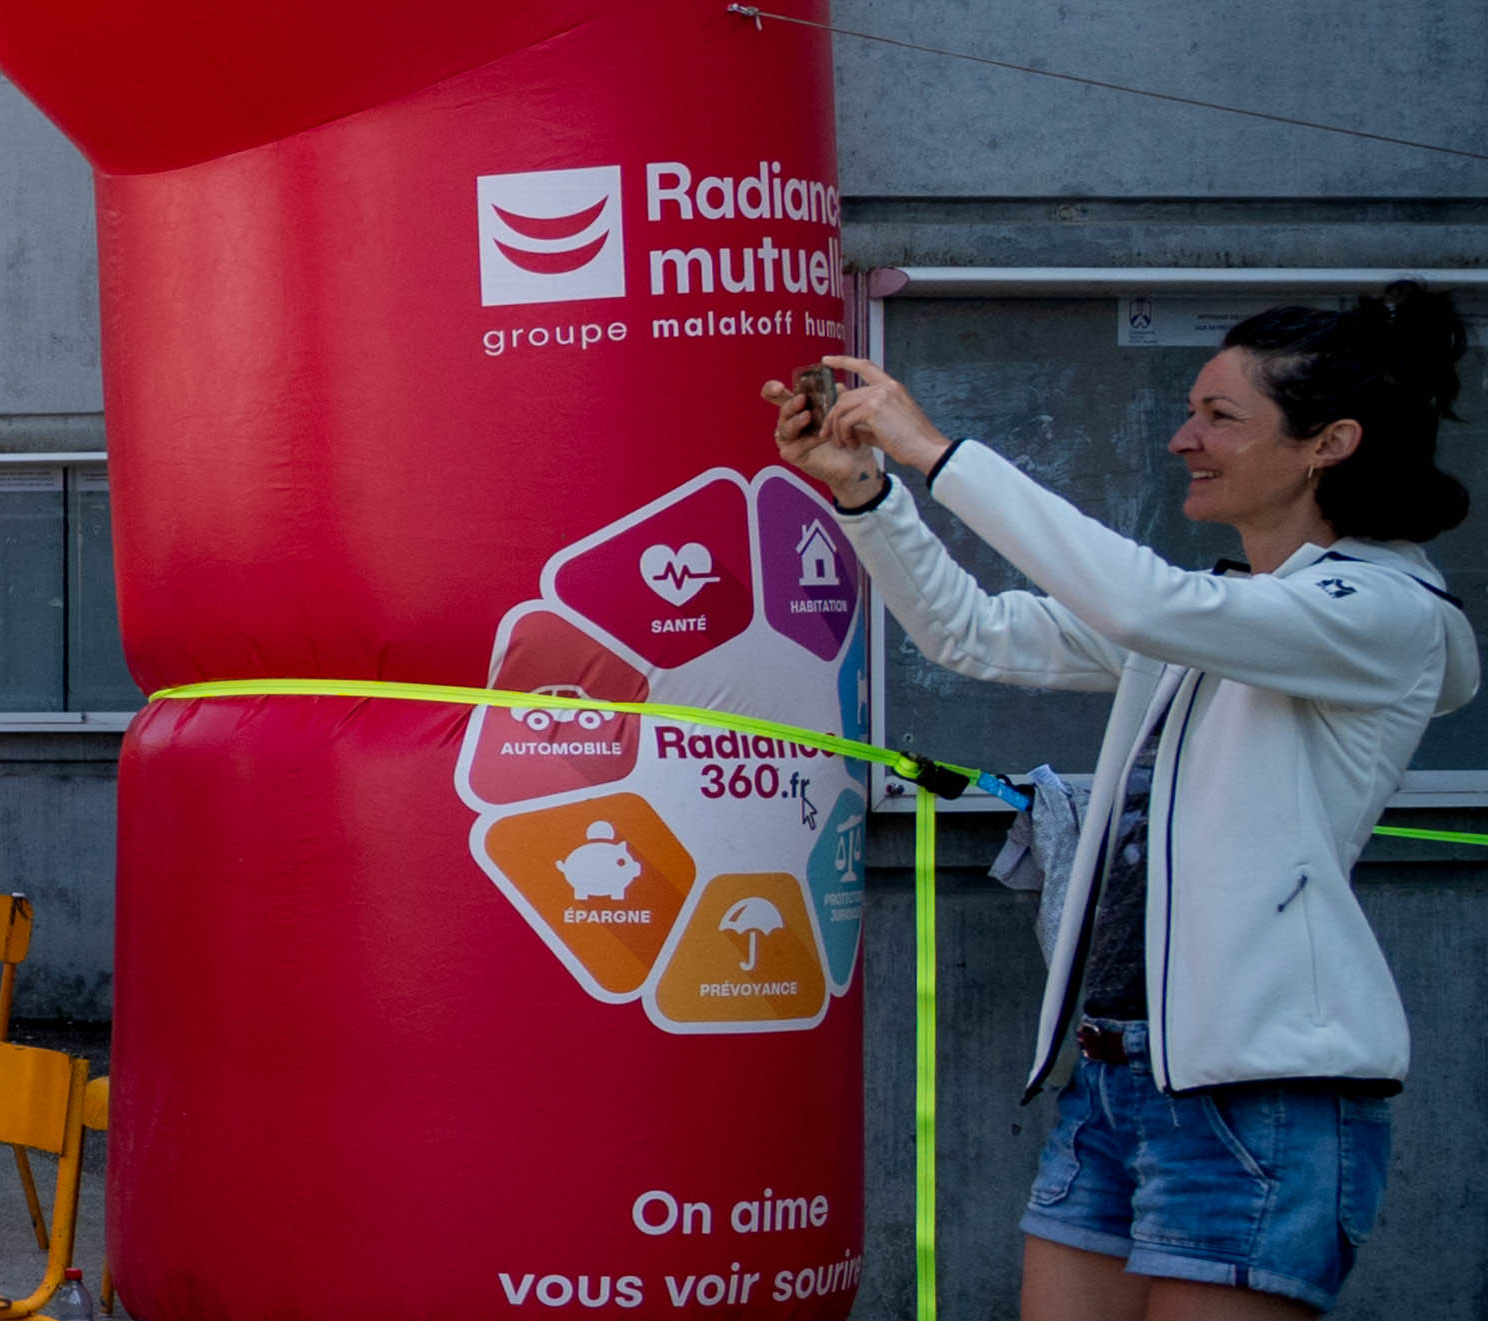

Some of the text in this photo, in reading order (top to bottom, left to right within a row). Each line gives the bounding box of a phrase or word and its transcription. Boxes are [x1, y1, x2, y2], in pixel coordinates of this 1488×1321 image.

[646, 161, 841, 226] Radianc
[649, 237, 844, 299] mutuell
[482, 321, 627, 356] groupe
[652, 310, 792, 339] malakoff
[790, 599, 848, 614] HABITATION
[651, 615, 707, 633] SANTÉ
[501, 741, 622, 755] AUTOMOBILE
[563, 907, 651, 924] ÉPARGNE
[700, 981, 798, 997] PRÉVOYANCE
[632, 1188, 829, 1236] On aime
[498, 1273, 644, 1309] vous
[664, 1262, 761, 1308] voir
